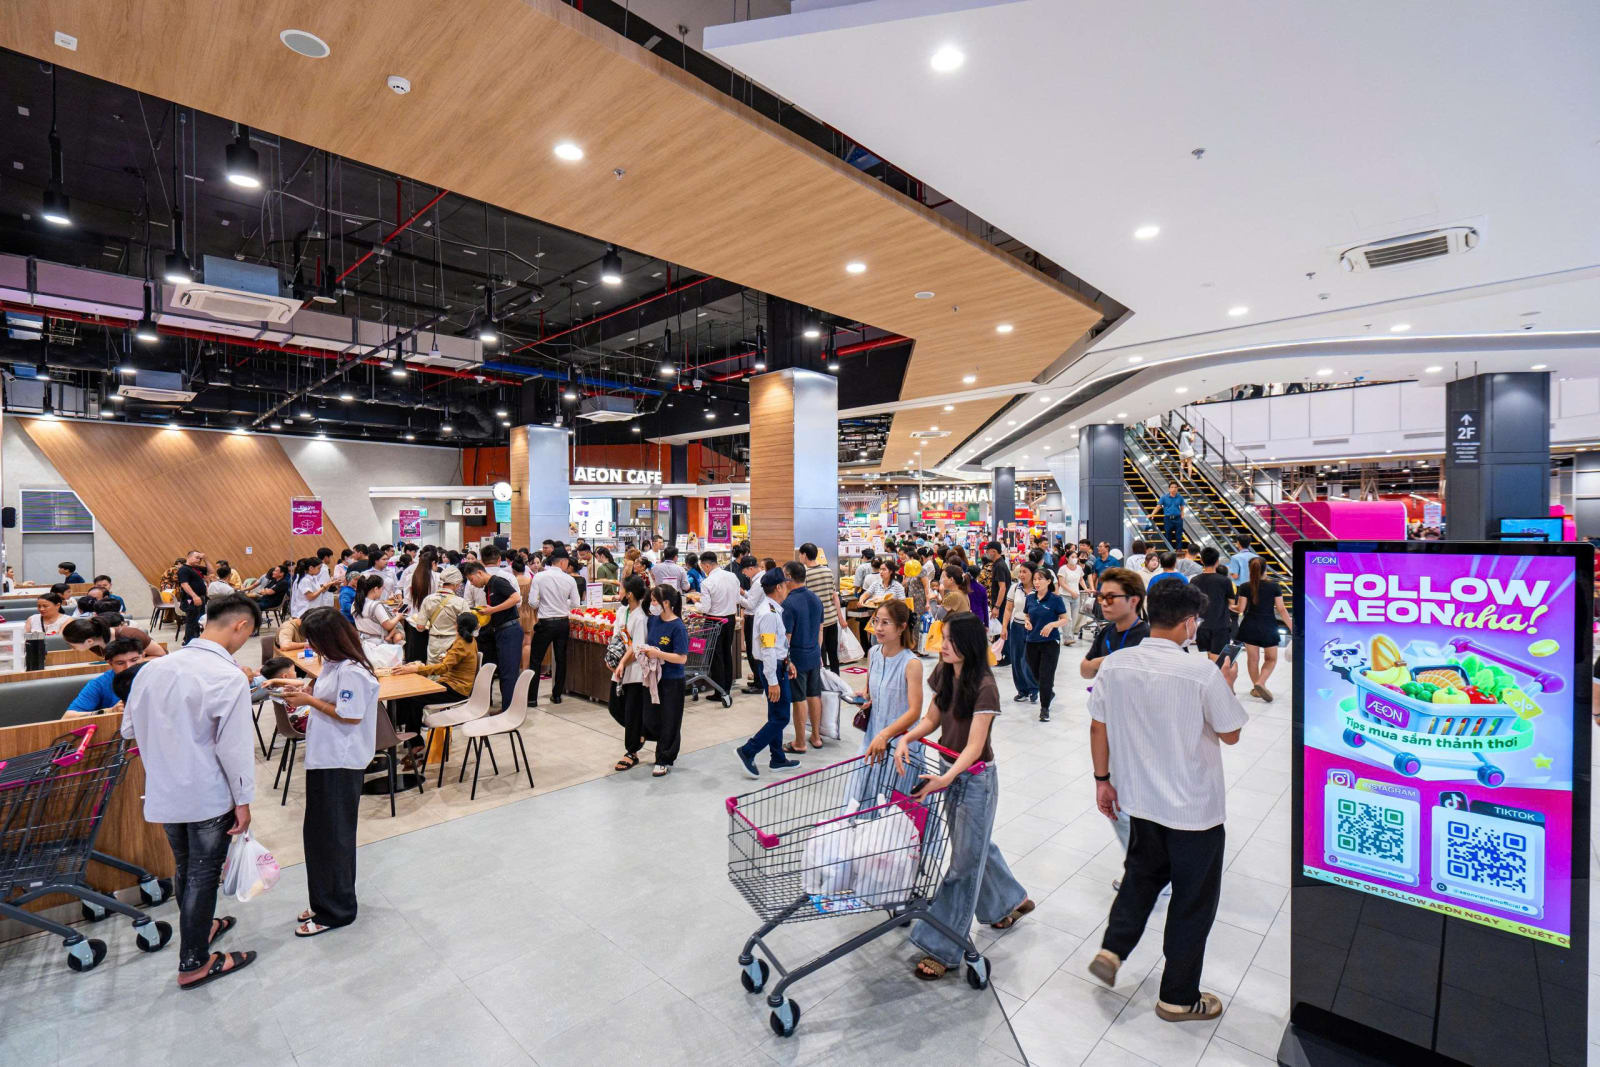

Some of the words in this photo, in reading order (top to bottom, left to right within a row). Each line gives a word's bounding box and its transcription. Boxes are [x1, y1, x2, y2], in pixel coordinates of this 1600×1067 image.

[1457, 427, 1476, 439] 2F
[574, 467, 622, 482] AEON
[627, 470, 662, 485] CAFE
[1324, 572, 1551, 607] FOLLOW
[1325, 599, 1455, 626] AEON
[1453, 604, 1549, 634] nha!
[1345, 716, 1366, 736] Tips
[1368, 725, 1398, 741] mua
[1493, 806, 1535, 821] TIKTOK
[1381, 889, 1426, 906] FOLLOW
[1429, 901, 1462, 916] AEON
[1464, 912, 1500, 926] NGAY
